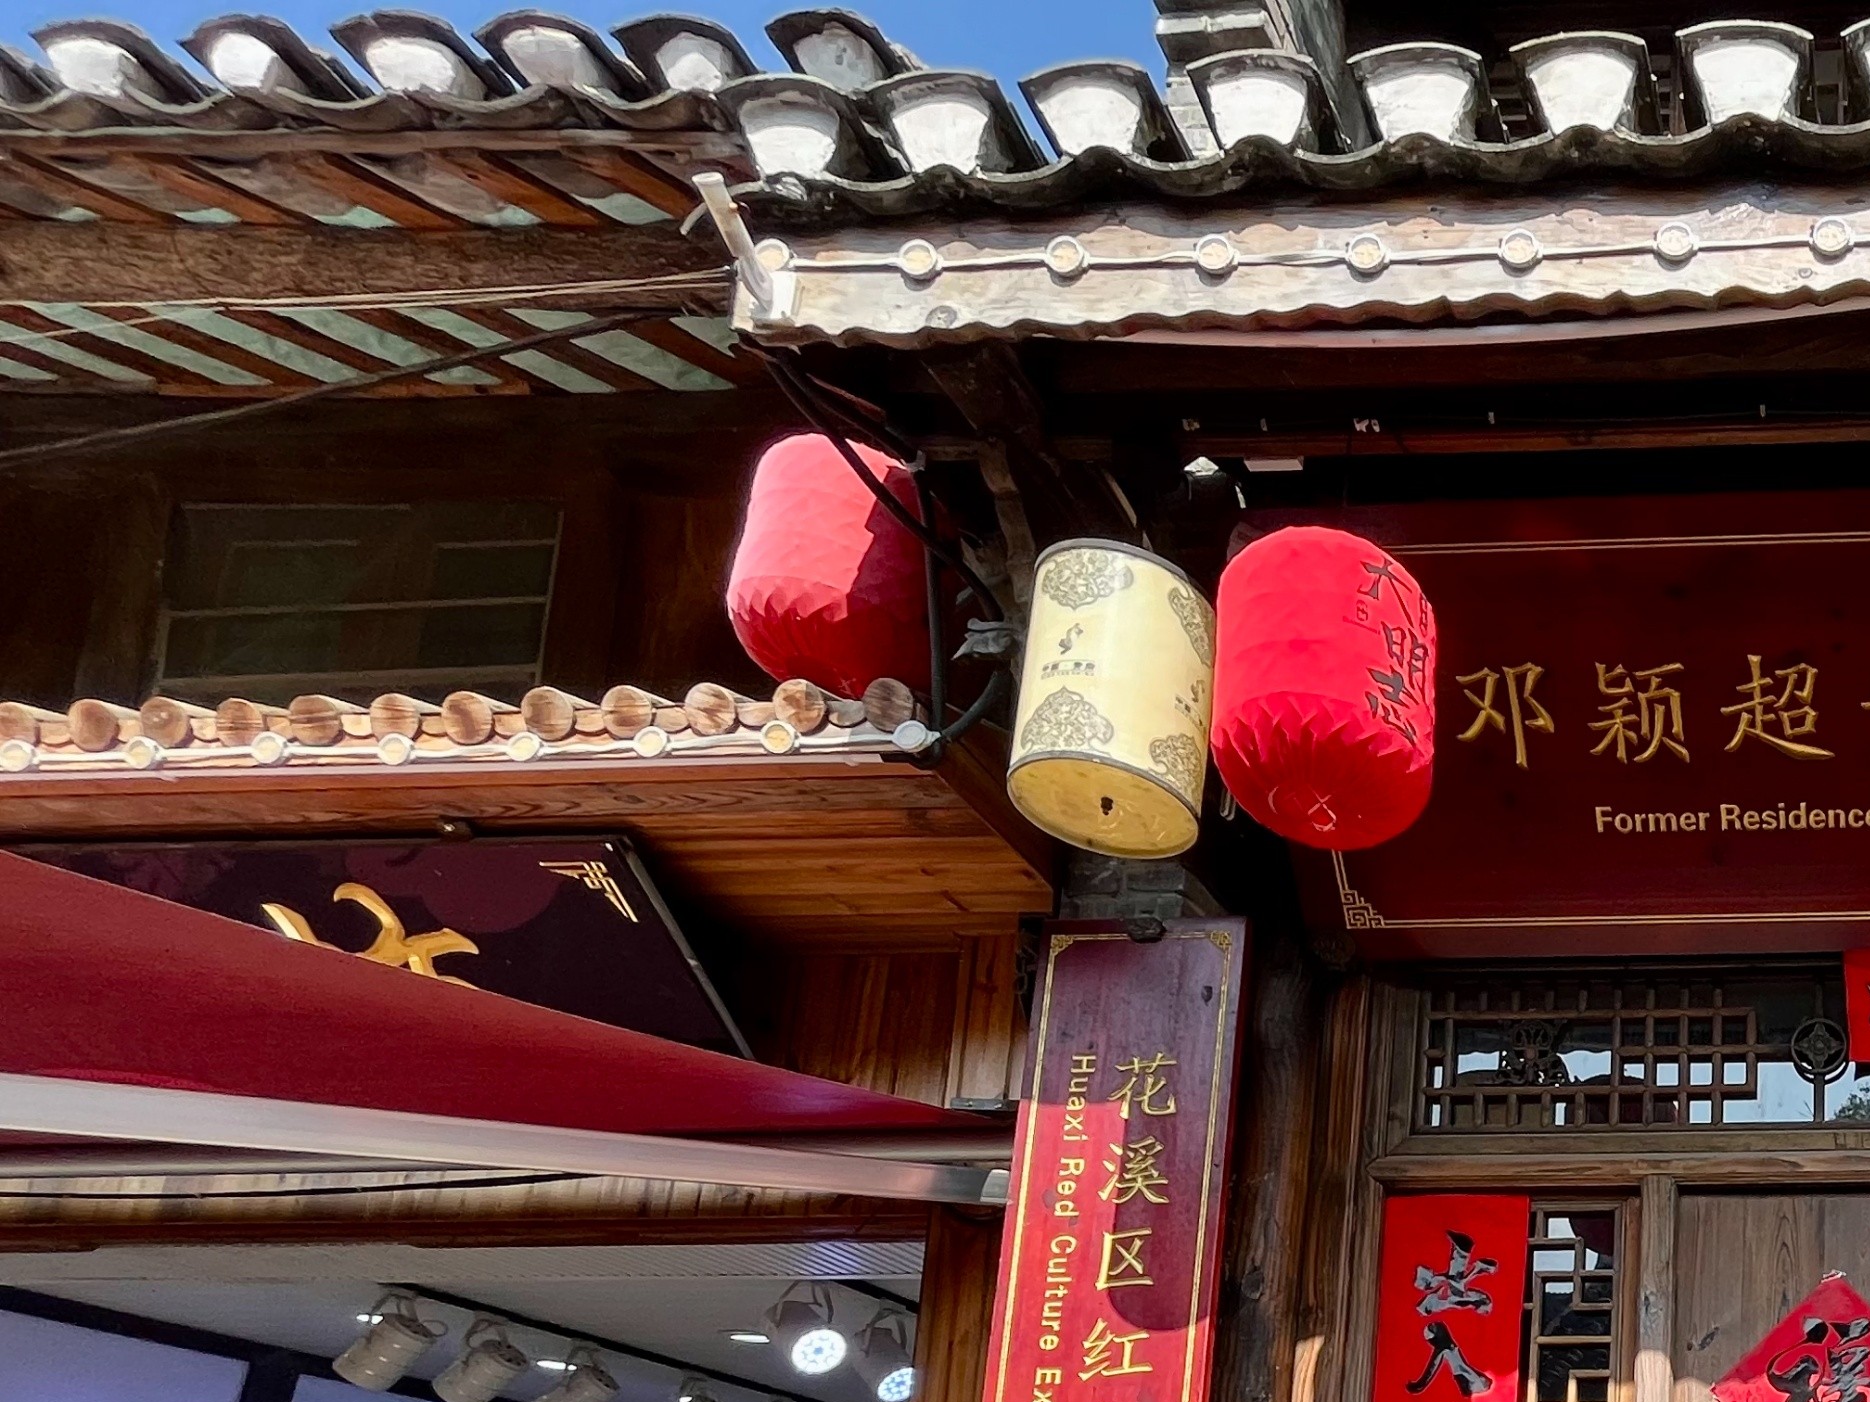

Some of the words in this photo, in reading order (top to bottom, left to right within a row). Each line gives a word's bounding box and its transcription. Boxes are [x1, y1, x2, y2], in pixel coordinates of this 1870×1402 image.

[1594, 805, 1710, 833] Former
[1062, 1053, 1096, 1143] Huaxi
[1053, 1157, 1085, 1219] Red
[1037, 1234, 1078, 1353] Culture
